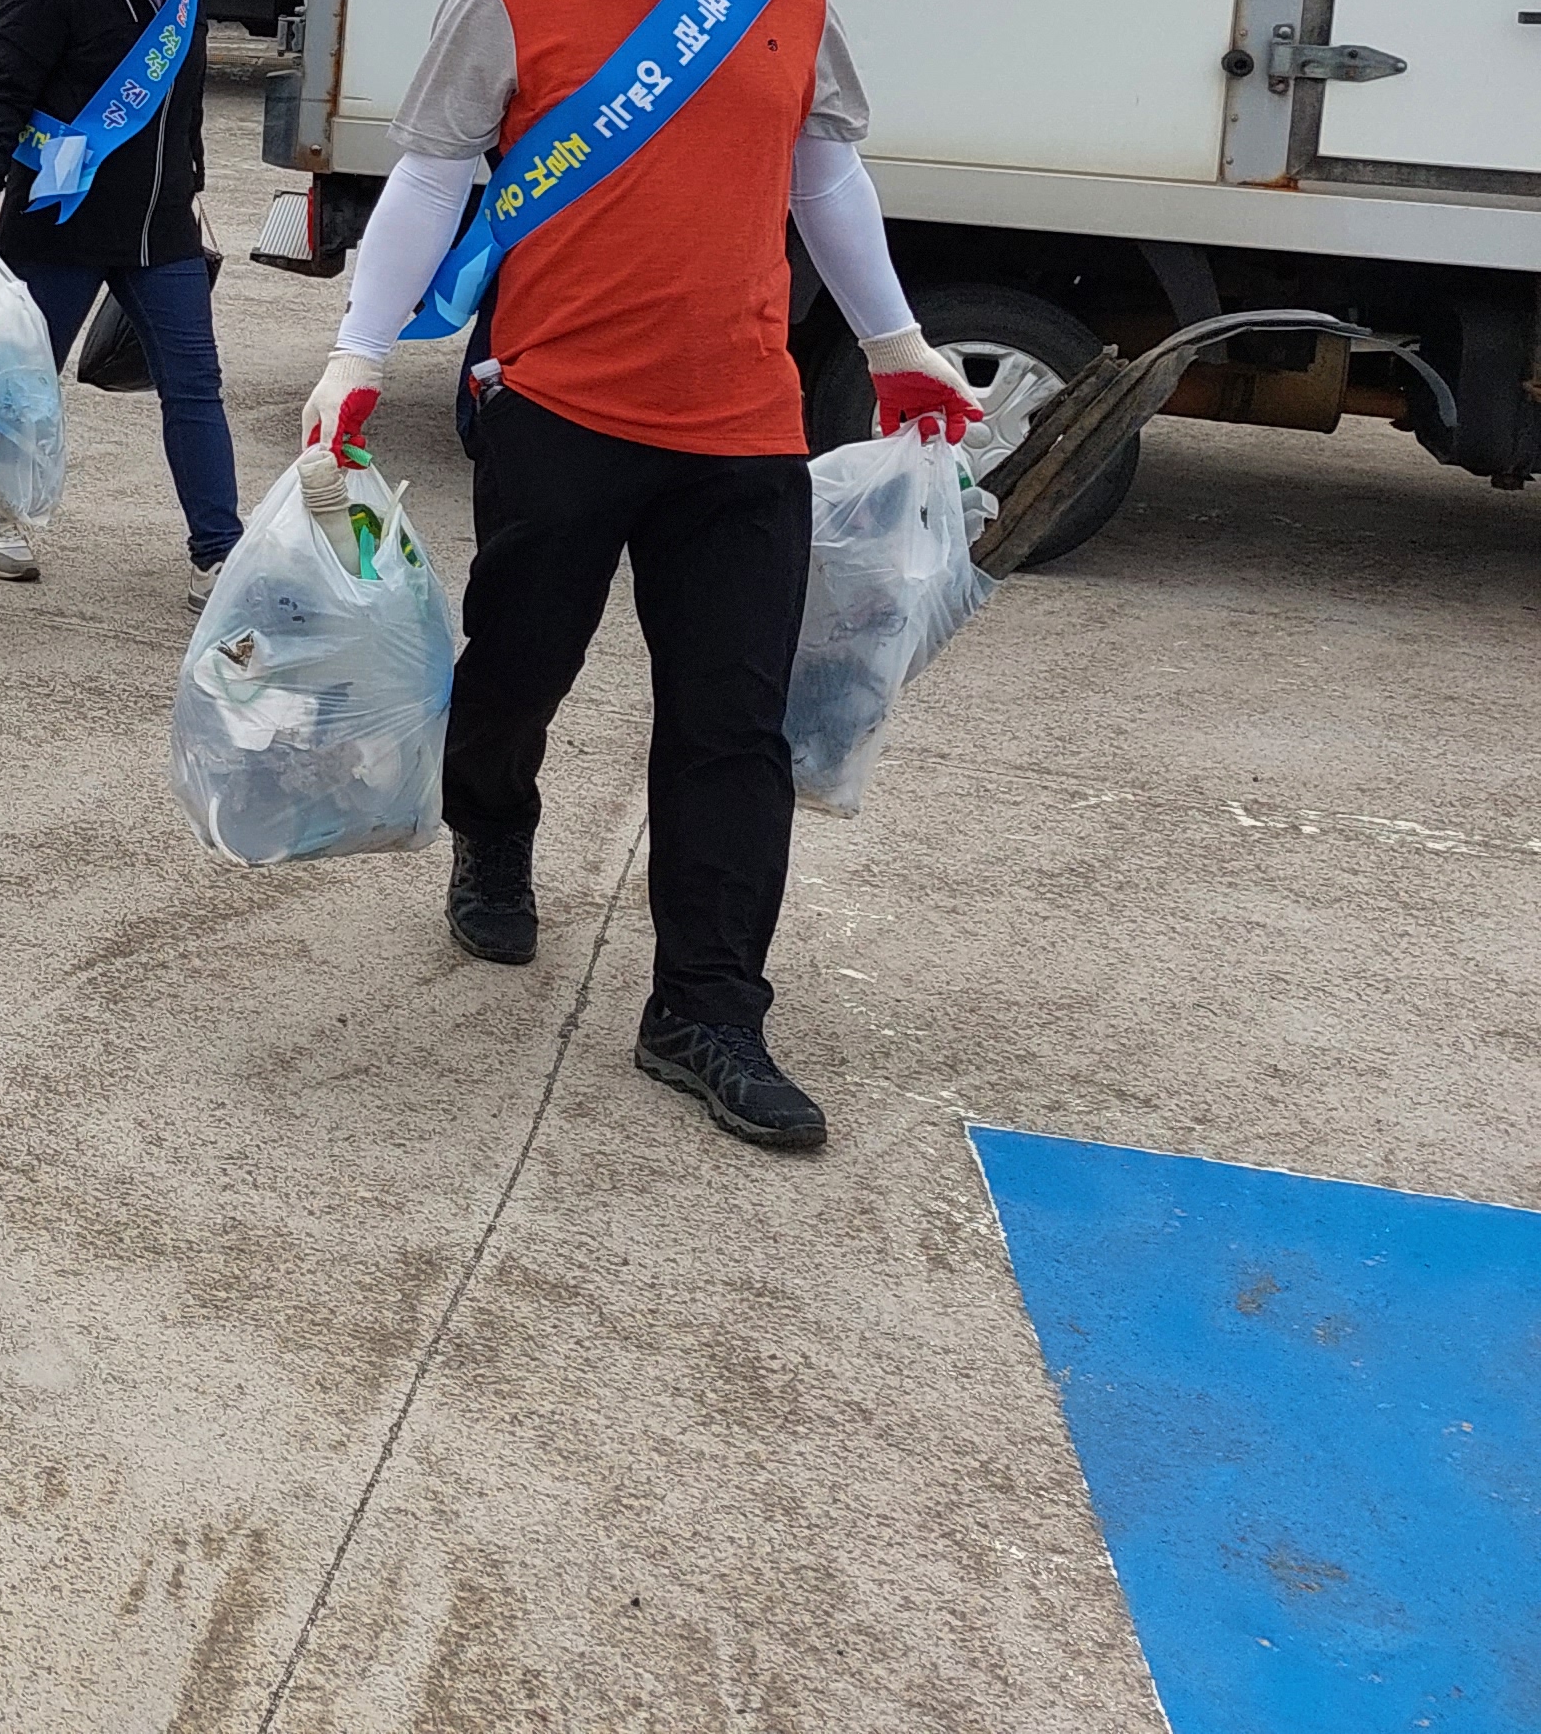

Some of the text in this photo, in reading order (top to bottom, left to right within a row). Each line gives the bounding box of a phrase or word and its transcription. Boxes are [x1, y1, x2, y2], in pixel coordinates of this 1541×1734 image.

[144, 24, 183, 82] 청정
[102, 78, 151, 131] 제주
[593, 59, 674, 141] 없는
[494, 131, 593, 224] 즐거운
